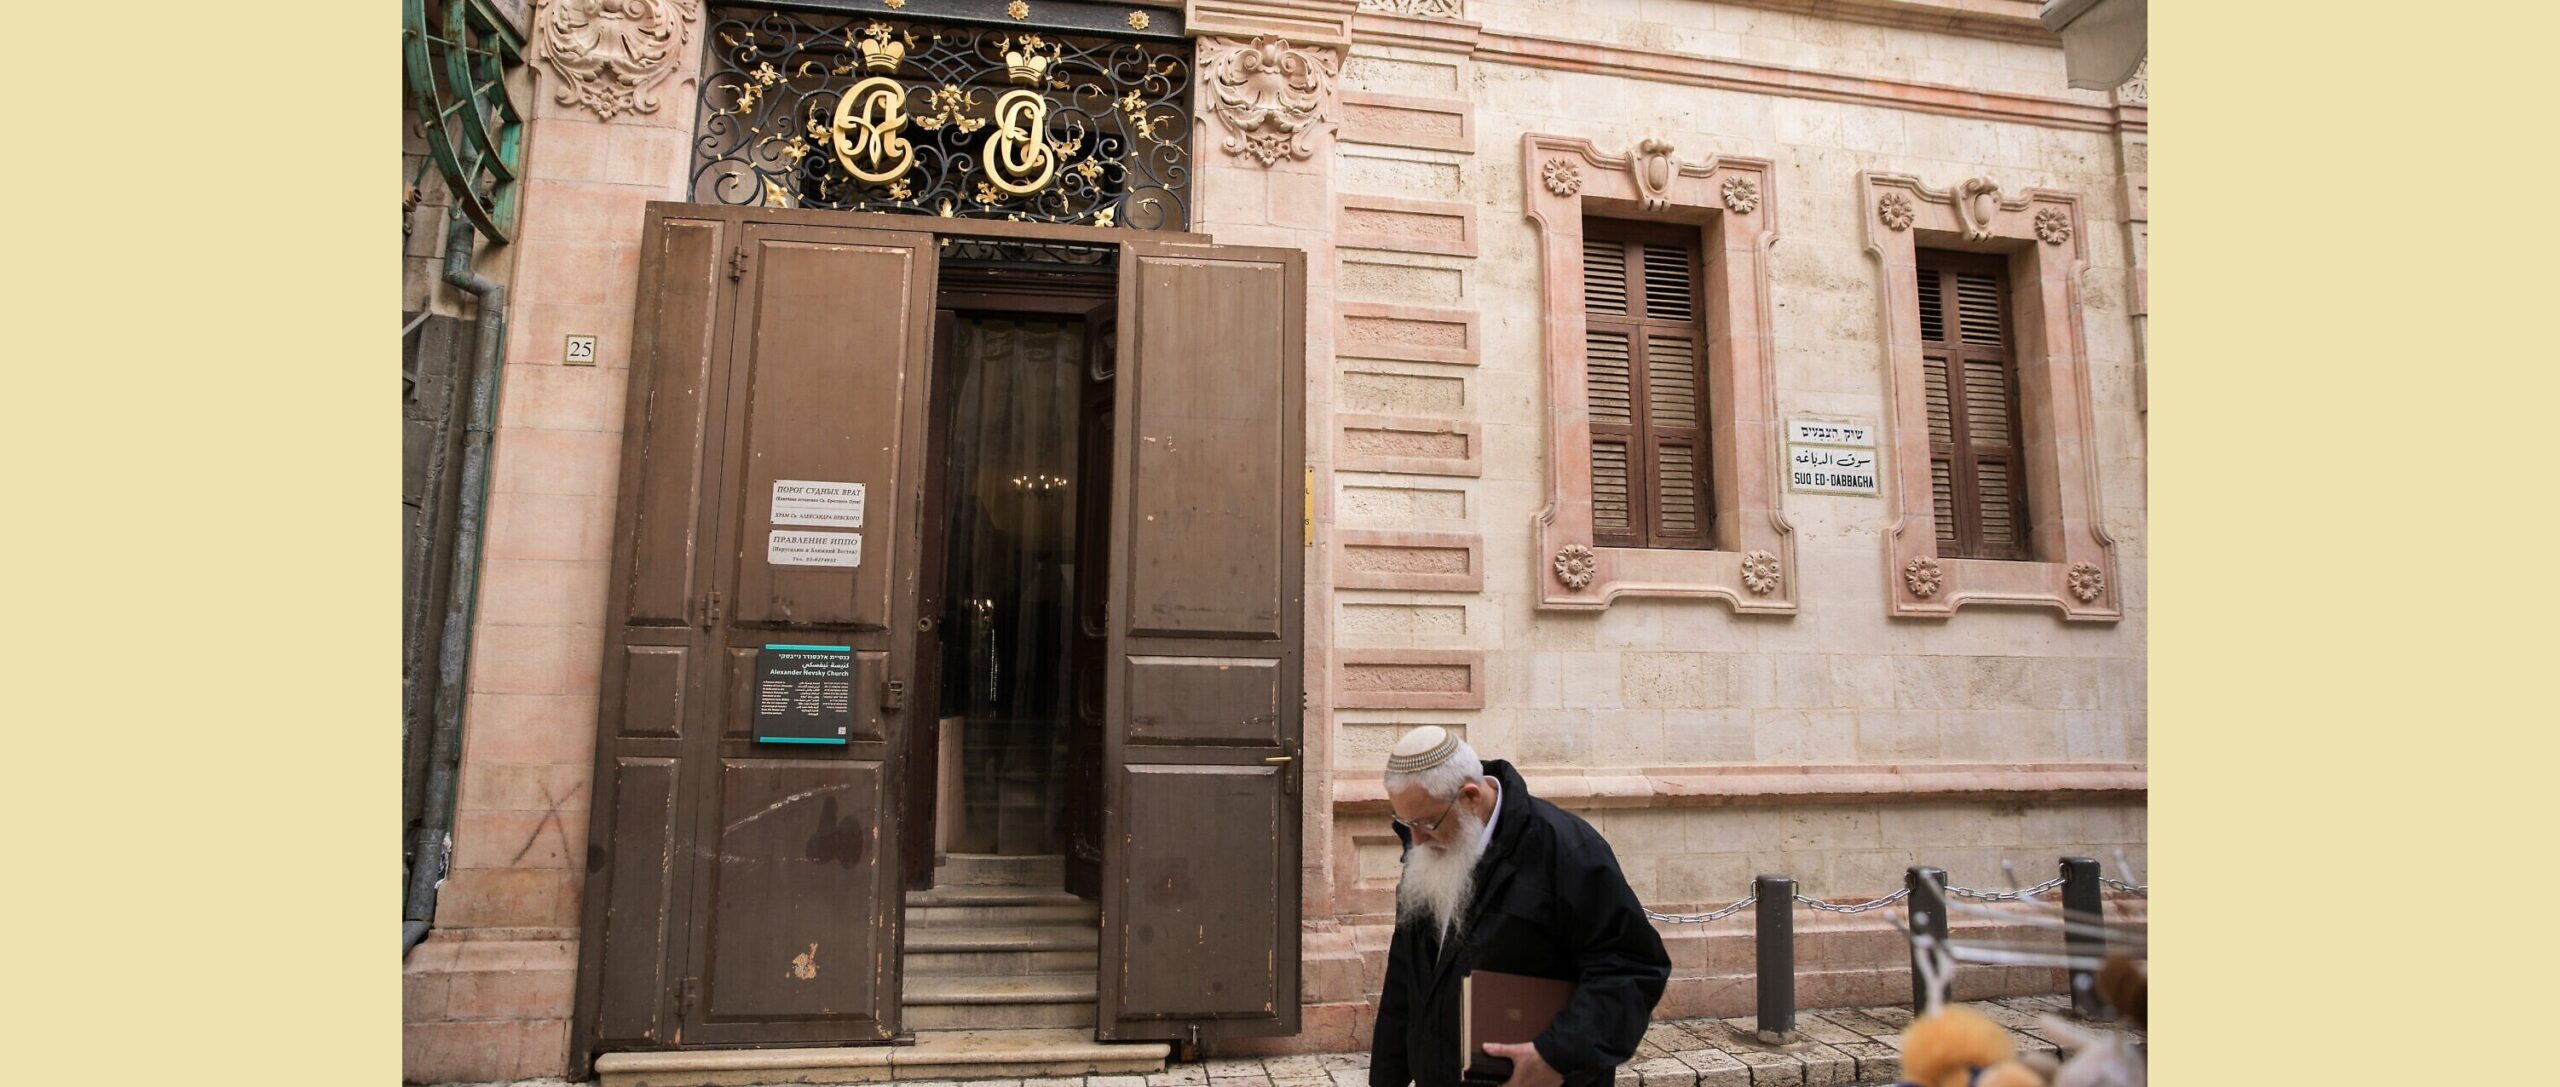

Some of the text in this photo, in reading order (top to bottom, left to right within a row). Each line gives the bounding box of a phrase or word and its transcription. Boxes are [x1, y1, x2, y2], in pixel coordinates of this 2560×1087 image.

[570, 341, 592, 357] 25
[1801, 426, 1863, 442] שוק הצבעים
[1836, 453, 1871, 468] سوق
[777, 486, 862, 497] ПОРОГ СУДНЫХ ВРАТ
[772, 536, 858, 546] ПРАВЛЕНИЕ ИППО
[830, 662, 850, 670] كنيسة
[769, 668, 802, 676] Alexander
[803, 669, 826, 677] Nevsky
